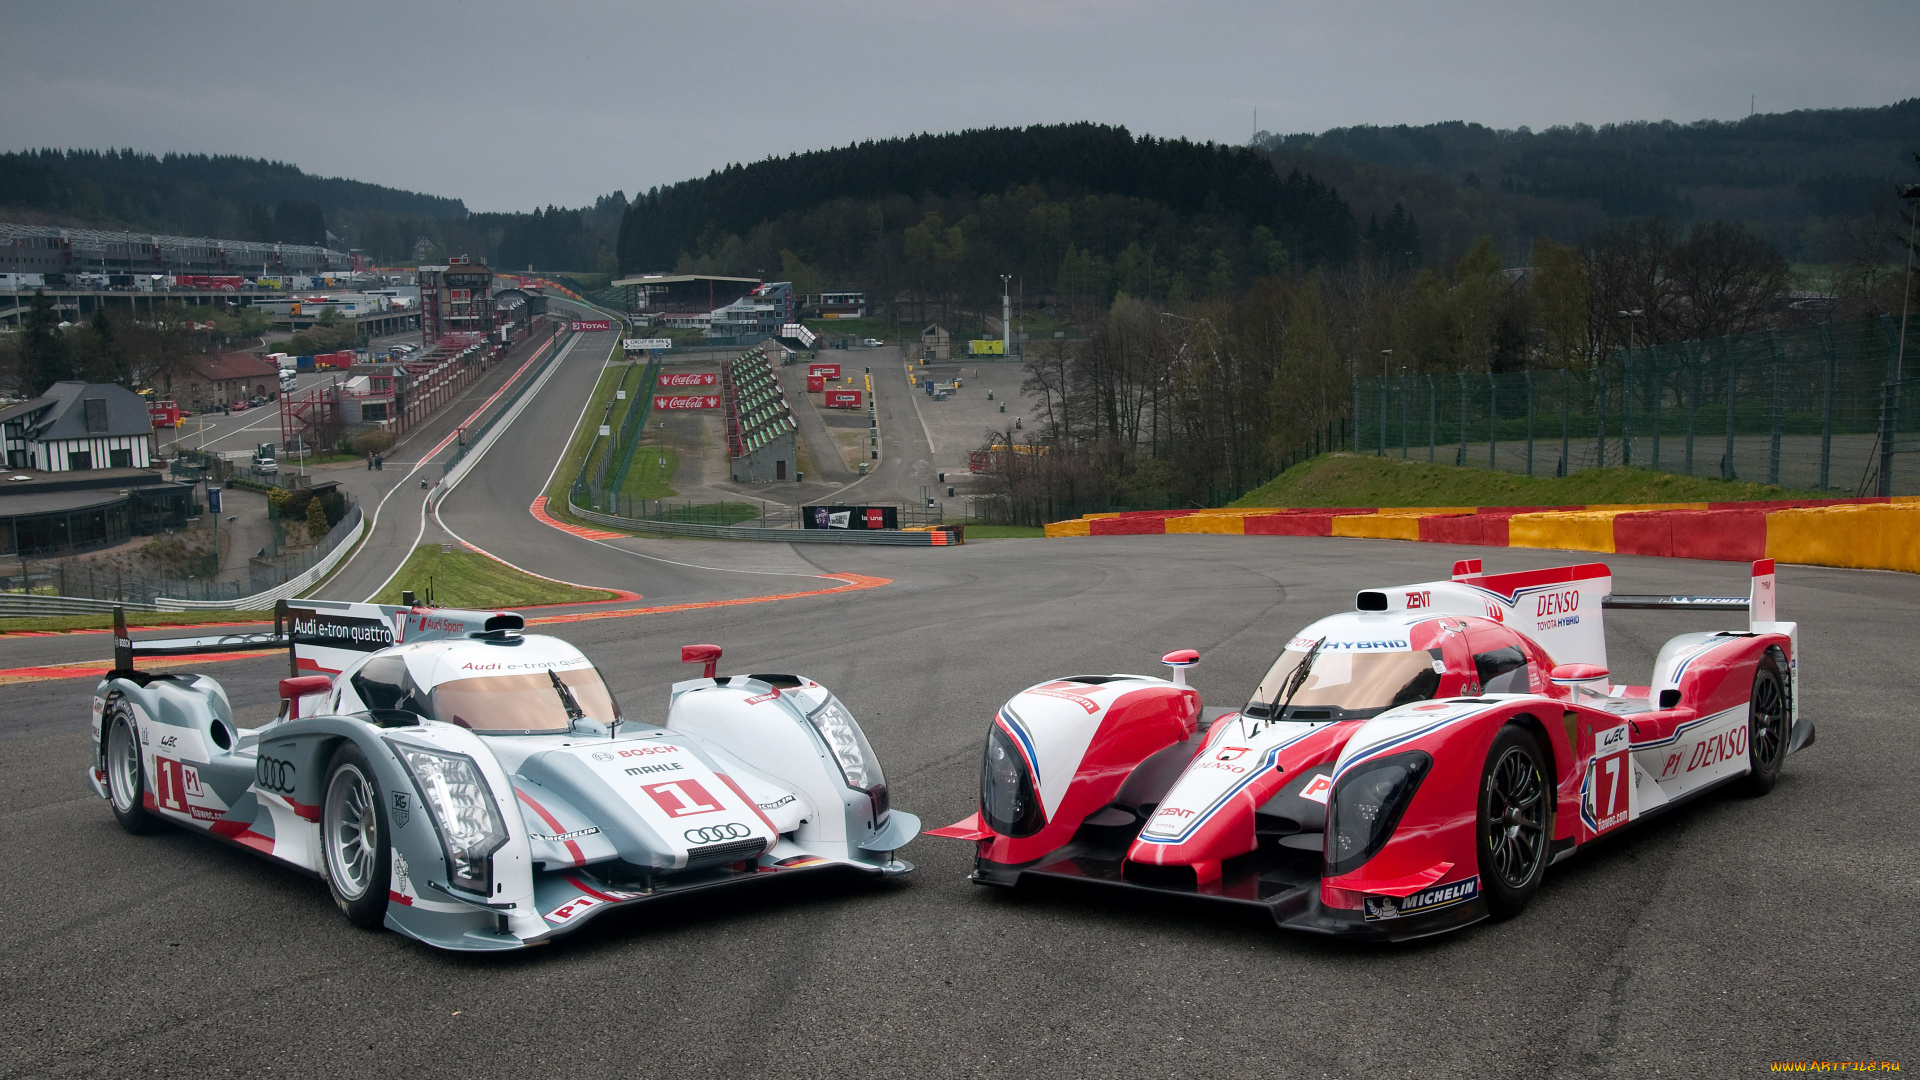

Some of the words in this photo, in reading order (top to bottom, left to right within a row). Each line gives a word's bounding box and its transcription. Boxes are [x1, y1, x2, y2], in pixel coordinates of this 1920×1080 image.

[1405, 591, 1431, 609] ZENT
[1537, 590, 1579, 617] DENSO
[294, 618, 317, 635] Audi
[318, 623, 349, 639] e-tron
[351, 625, 391, 644] quattro
[427, 619, 442, 630] Audi
[443, 619, 463, 633] Sport
[1537, 619, 1557, 631] TOYOTA
[1557, 615, 1580, 627] HYBRID
[119, 639, 130, 648] BOSCH
[1323, 640, 1408, 649] HYBRID
[462, 662, 501, 670] Audi
[507, 661, 556, 669] e-tron
[161, 736, 178, 748] WEC
[1604, 727, 1625, 746] WEC
[618, 745, 679, 758] BOSCH
[1687, 725, 1747, 772] DENSO
[624, 762, 684, 776] MAHLE
[1194, 762, 1245, 773] DENSO
[1661, 752, 1682, 777] P1
[162, 761, 180, 809] 1
[185, 769, 199, 792] P1
[1305, 779, 1330, 796] P
[1605, 757, 1620, 816] 7
[394, 794, 407, 809] TAG
[652, 782, 716, 816] 1
[1158, 807, 1195, 819] ZENT
[1598, 809, 1628, 832] fiawec.com
[545, 827, 596, 841] MICHELIN
[1401, 881, 1475, 909] MICHELIN
[554, 899, 594, 918] P1
